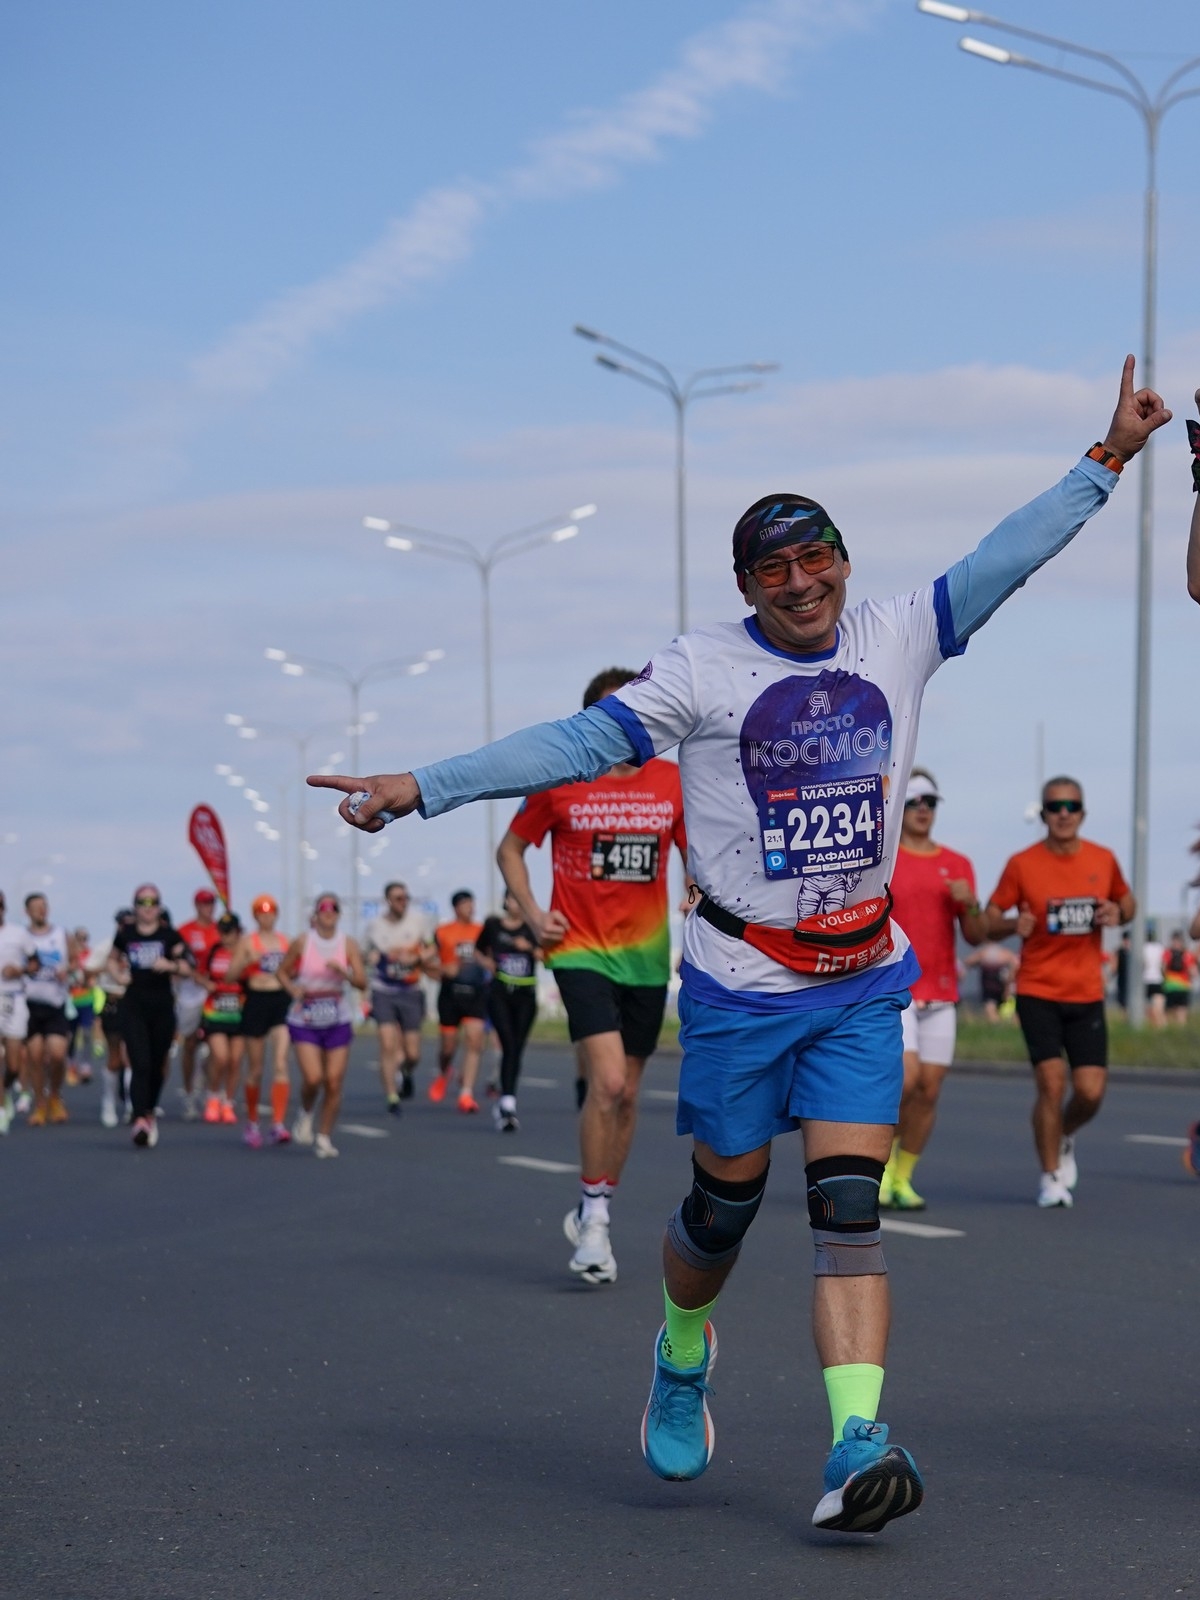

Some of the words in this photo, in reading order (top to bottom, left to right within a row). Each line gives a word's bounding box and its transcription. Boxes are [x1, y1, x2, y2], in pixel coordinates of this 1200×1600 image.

[759, 522, 789, 541] GTRAIL
[808, 690, 832, 718] Я
[791, 713, 856, 736] ПРОСТО
[749, 719, 890, 768] КОСМОС
[801, 781, 876, 800] МАРАФОН
[569, 800, 674, 816] САМАРСКИЙ
[571, 815, 674, 832] МАРАФОН
[787, 800, 876, 851] 2234
[767, 835, 783, 843] 21,1
[607, 844, 652, 869] 4151
[770, 855, 782, 867] D
[807, 848, 864, 864] РАФАИЛ
